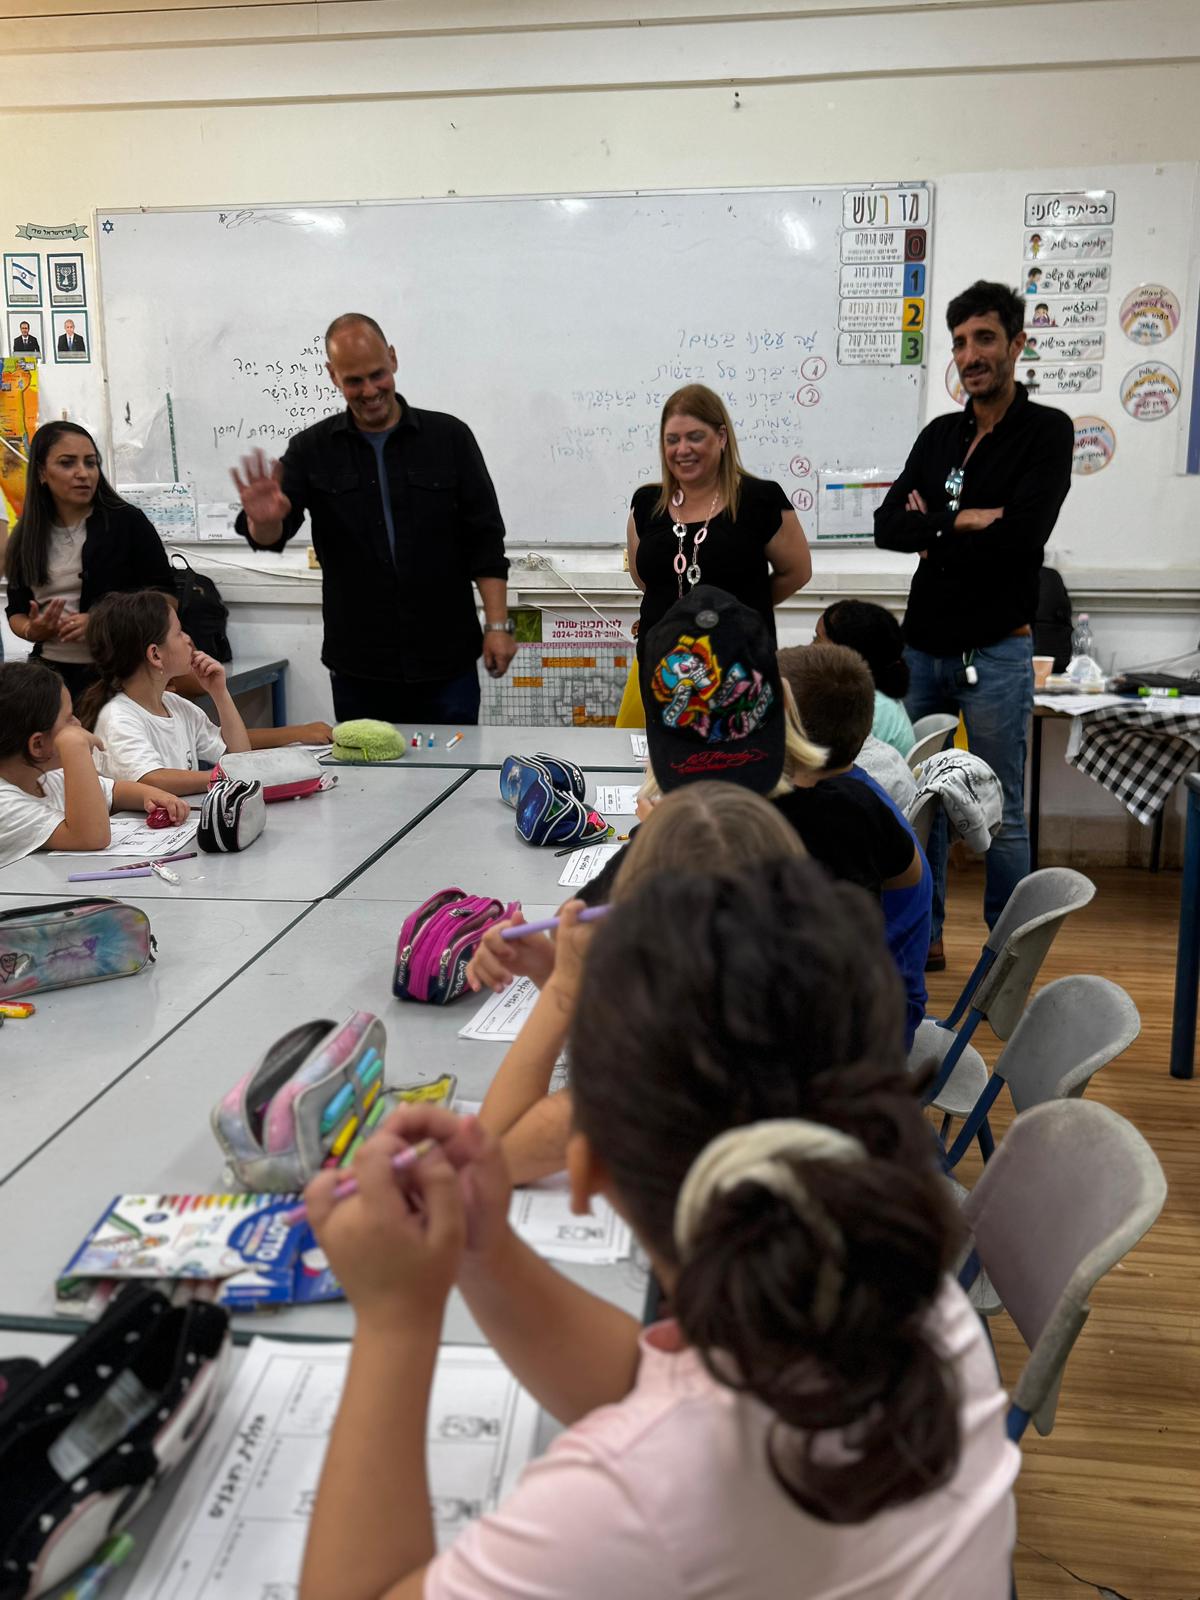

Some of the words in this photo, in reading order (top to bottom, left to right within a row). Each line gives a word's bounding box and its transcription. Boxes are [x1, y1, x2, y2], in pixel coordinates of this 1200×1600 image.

[853, 192, 889, 226] רעש
[898, 193, 919, 223] מד
[1067, 204, 1108, 217] בכיתה
[911, 269, 919, 291] 1
[907, 303, 921, 326] 2
[906, 337, 919, 360] 3
[552, 630, 593, 638] 2024-2025
[555, 619, 577, 629] שנתי
